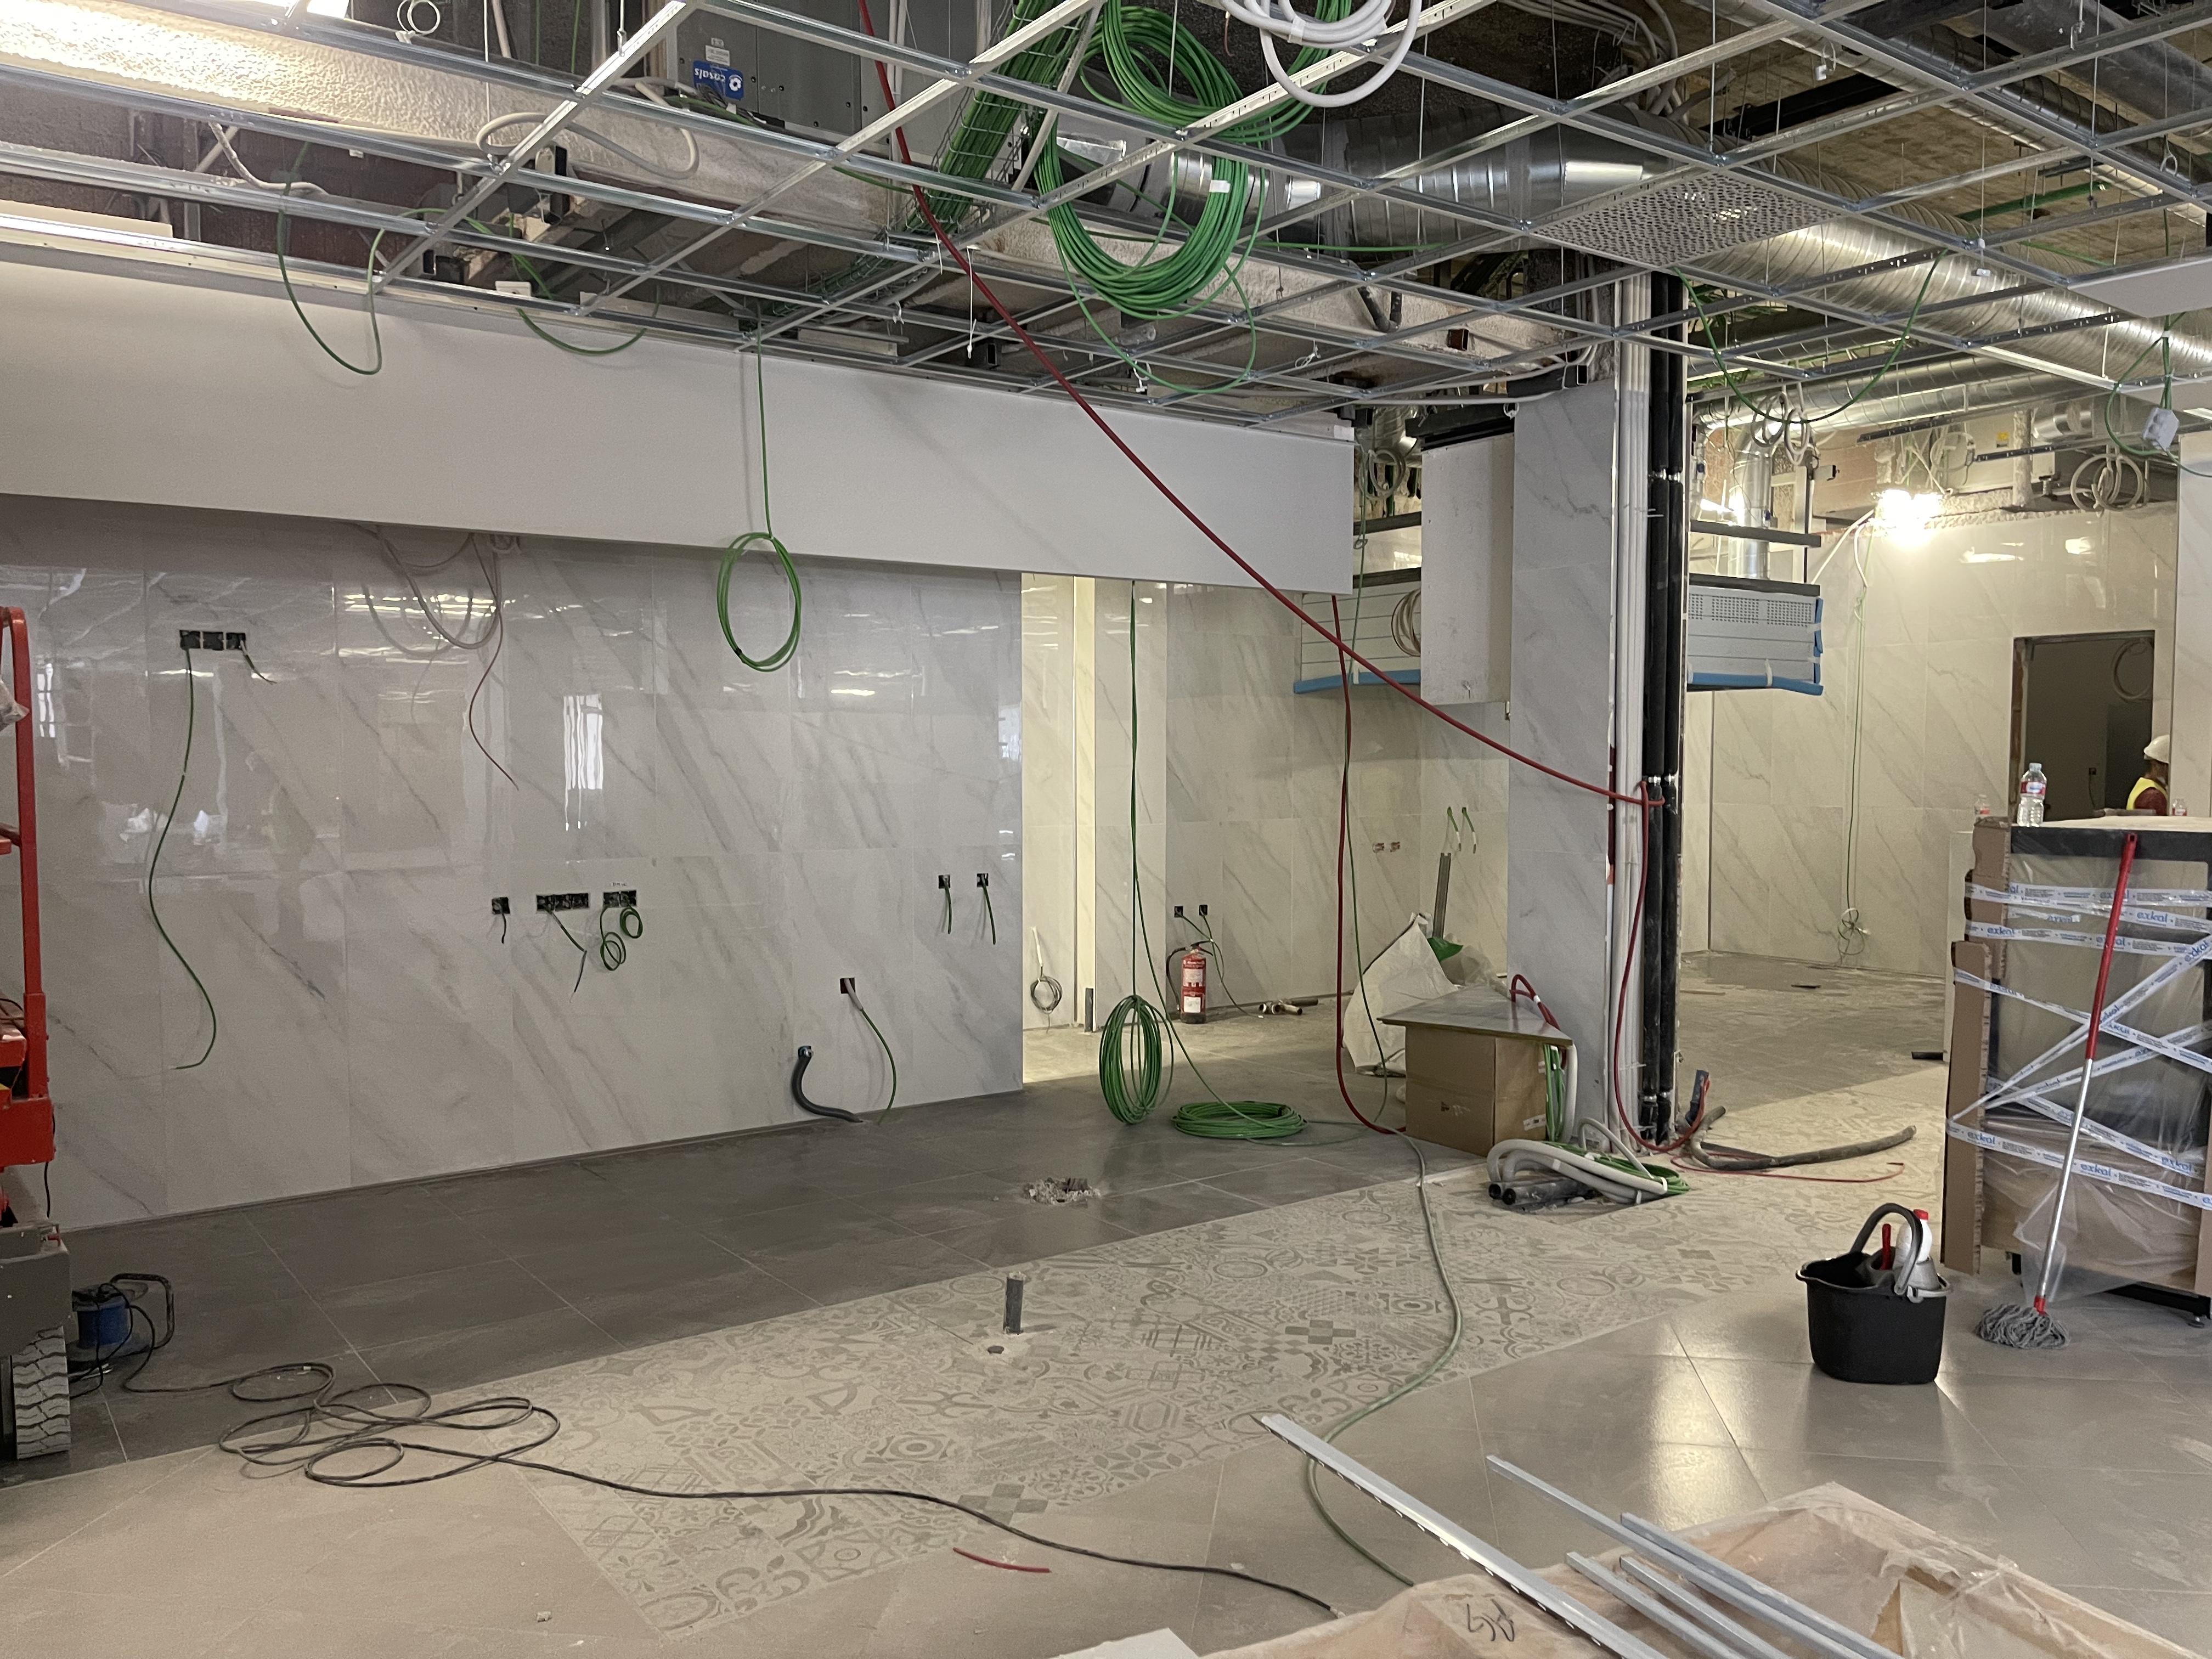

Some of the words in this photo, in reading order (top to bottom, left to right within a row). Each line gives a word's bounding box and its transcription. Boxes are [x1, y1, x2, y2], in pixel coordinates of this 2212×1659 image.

[695, 68, 726, 82] casals
[2137, 911, 2167, 922] exkal
[2096, 937, 2125, 946] eal
[1967, 1131, 1996, 1145] exkal
[2080, 1164, 2111, 1177] exkal
